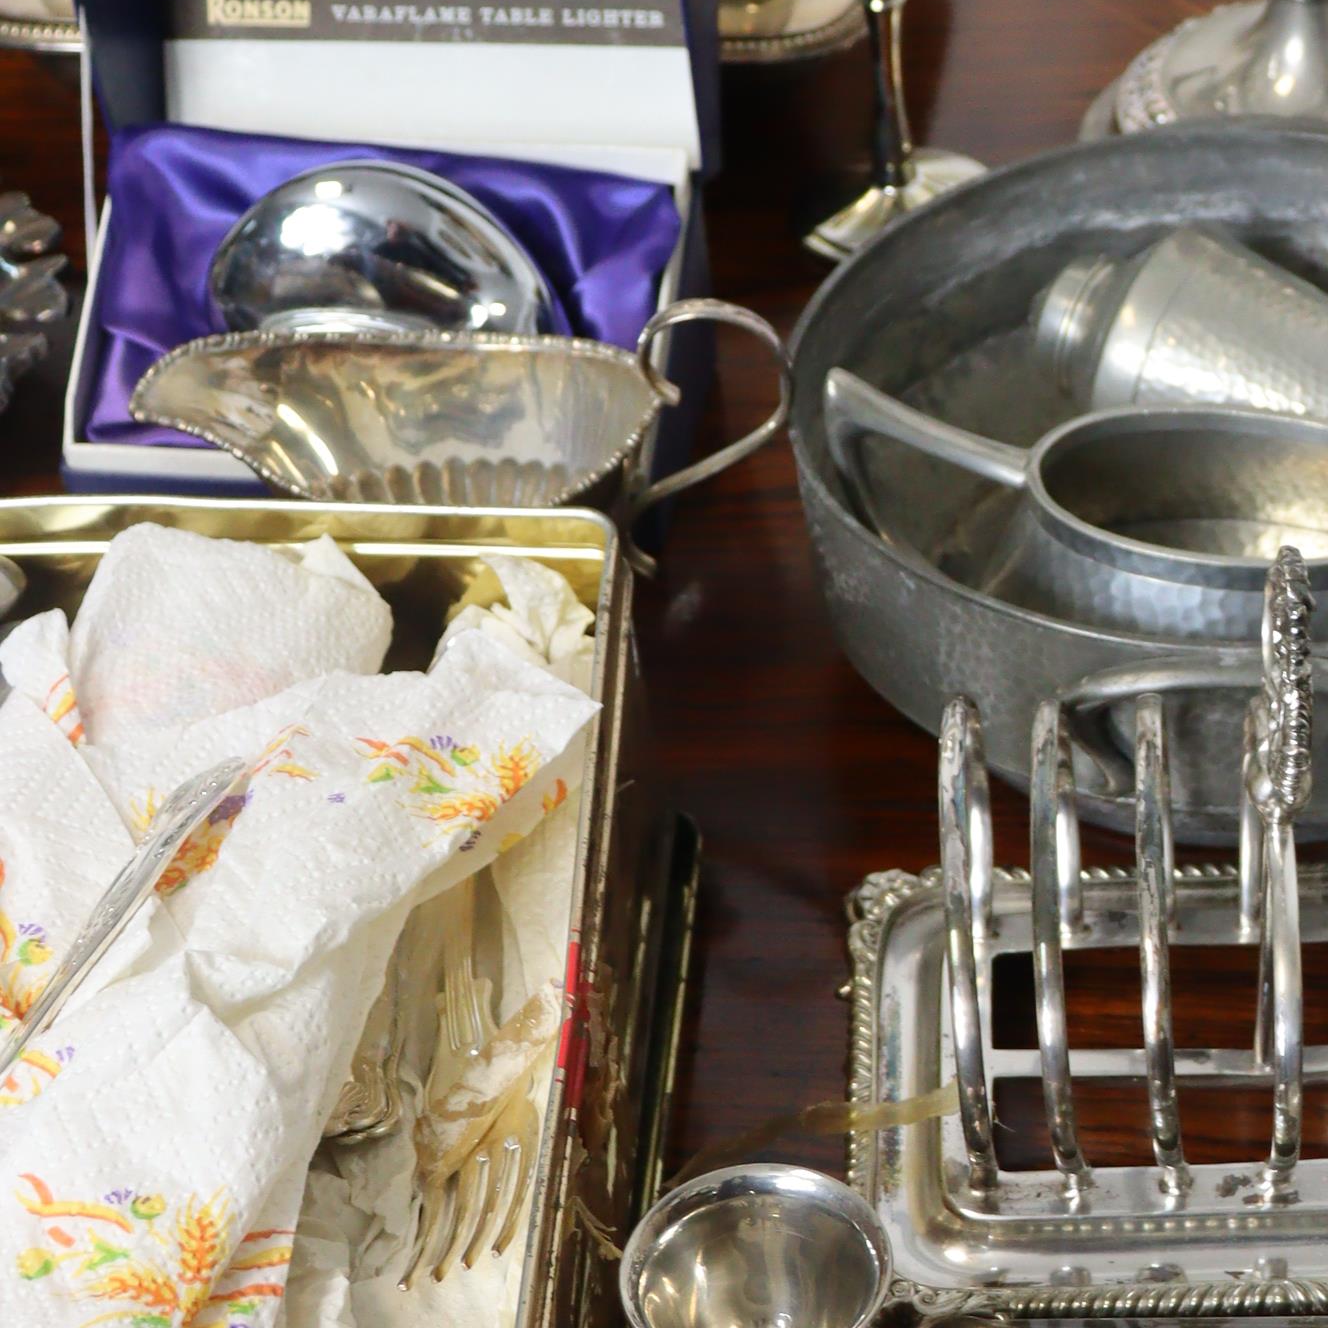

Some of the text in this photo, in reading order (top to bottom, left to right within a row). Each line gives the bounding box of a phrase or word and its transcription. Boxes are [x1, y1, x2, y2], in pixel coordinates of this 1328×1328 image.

[331, 4, 472, 25] VARAFLAME
[480, 6, 554, 26] TABLE
[561, 8, 664, 28] LIGHTER
